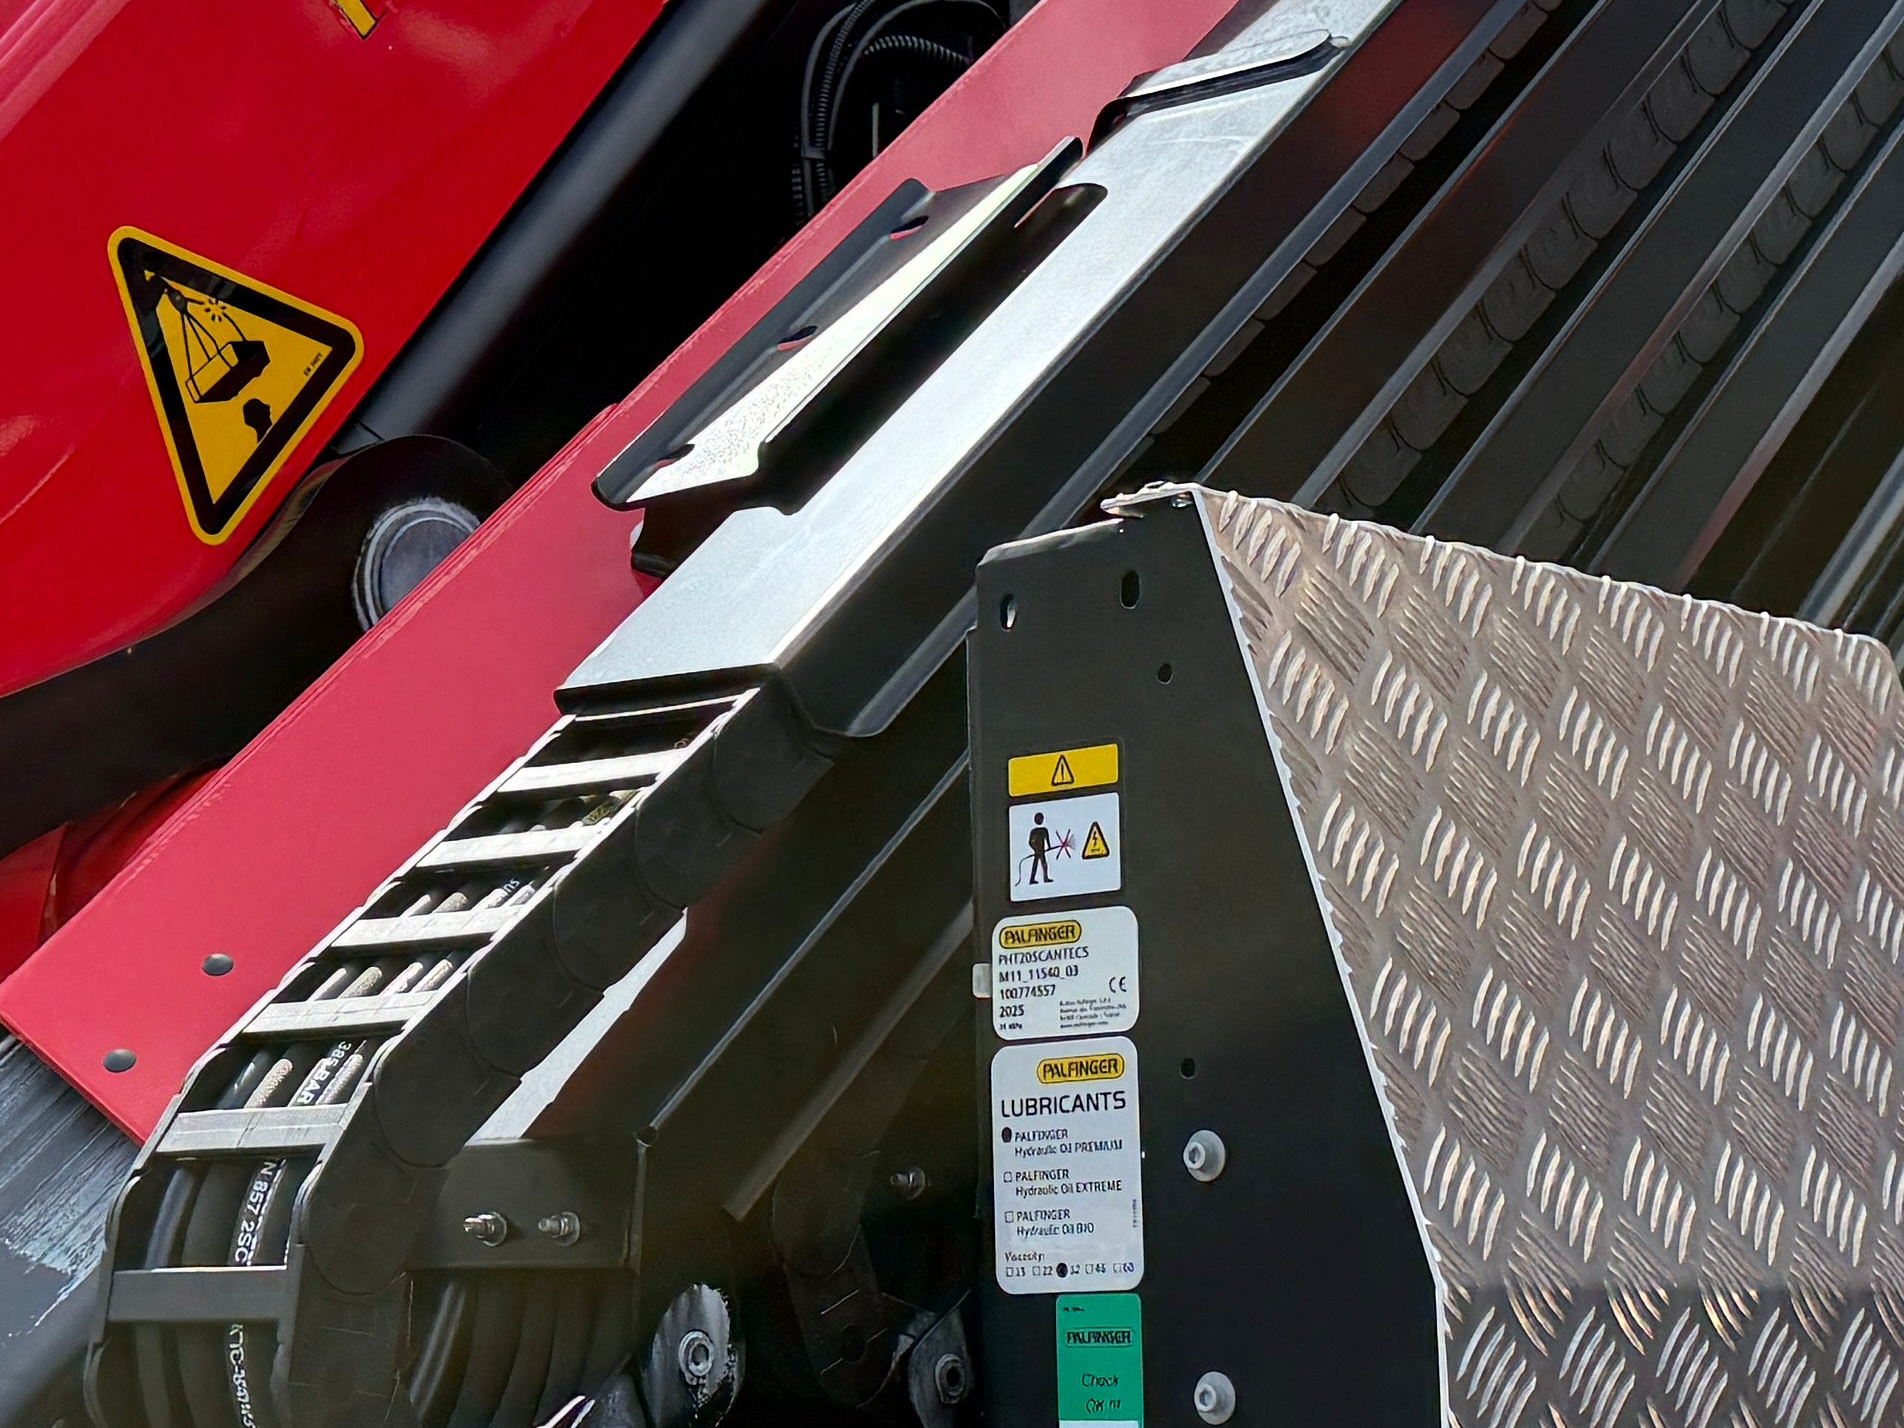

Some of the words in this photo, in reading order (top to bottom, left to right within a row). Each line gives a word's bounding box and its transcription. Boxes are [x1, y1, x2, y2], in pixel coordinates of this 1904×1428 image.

[1004, 924, 1075, 945] PALFINGER
[999, 1005, 1025, 1018] 2025
[1043, 1058, 1118, 1079] PALFINGER
[297, 1069, 330, 1104] BAR
[1001, 1091, 1126, 1118] LUBRICANTS
[1015, 1145, 1057, 1158] Hydraulic
[1075, 1140, 1123, 1152] PREMIUM
[1015, 1169, 1069, 1182] PALFINGER
[247, 1180, 269, 1215] 857
[1016, 1185, 1058, 1199] Hydraulic
[1060, 1183, 1074, 1194] Oil
[1076, 1180, 1122, 1193] EXTREME
[1016, 1209, 1070, 1222] PALFINGER
[1017, 1225, 1059, 1239] Hydraulic
